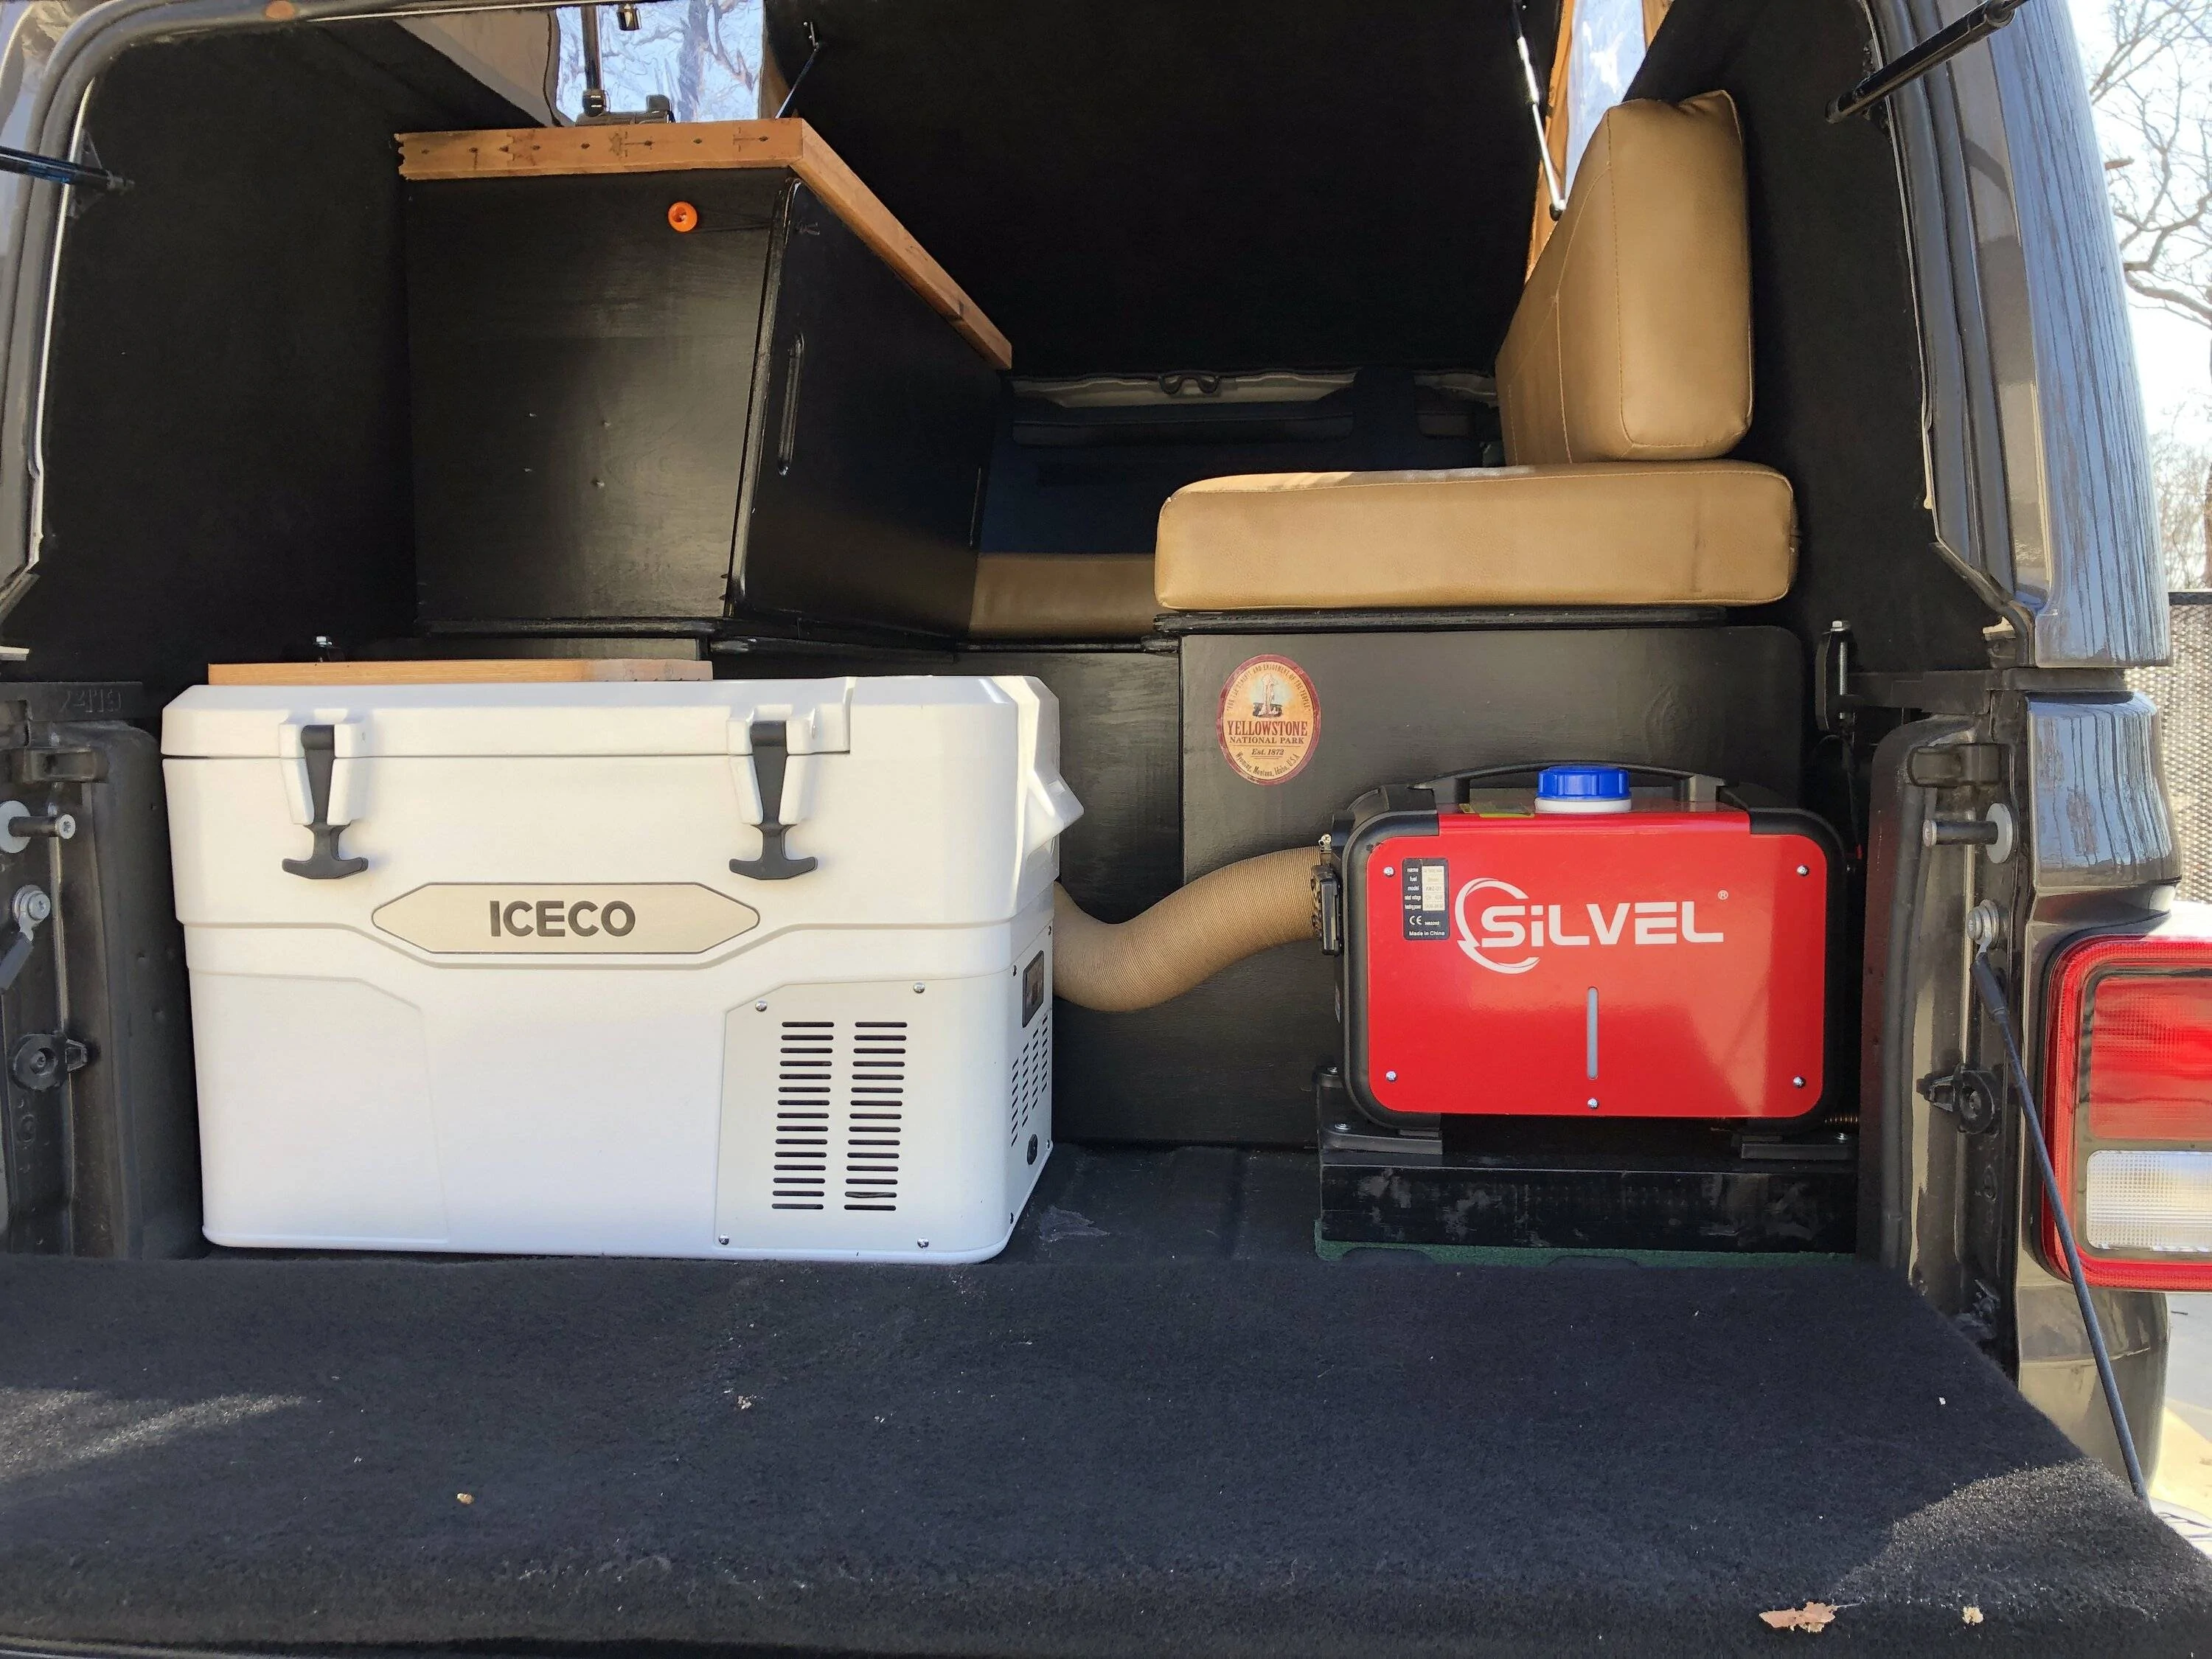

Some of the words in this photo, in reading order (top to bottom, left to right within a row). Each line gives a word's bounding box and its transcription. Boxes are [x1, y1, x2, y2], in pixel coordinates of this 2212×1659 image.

[1227, 720, 1308, 737] YELLOWSTONE
[490, 900, 636, 938] ICECO
[1409, 915, 1422, 925] CE
